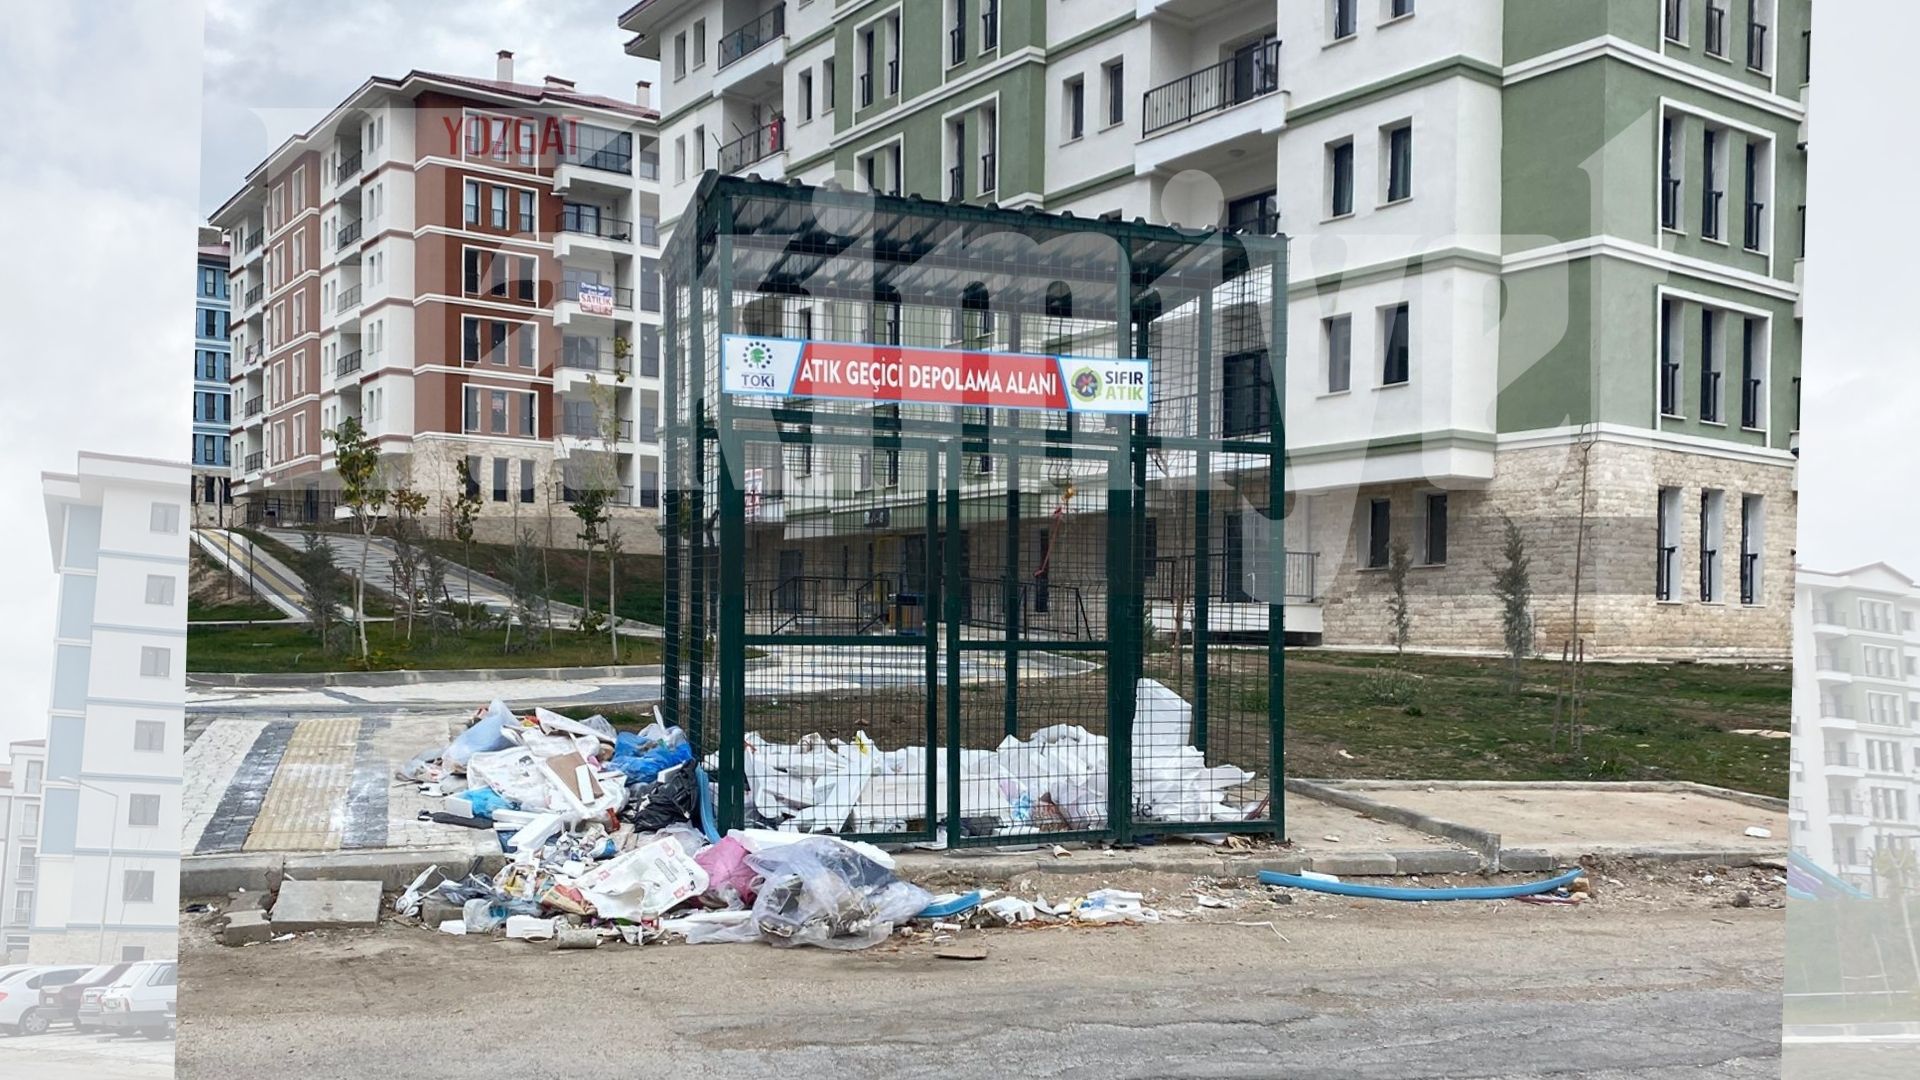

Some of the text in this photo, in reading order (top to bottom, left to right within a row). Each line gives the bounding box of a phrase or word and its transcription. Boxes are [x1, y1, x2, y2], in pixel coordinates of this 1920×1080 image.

[800, 356, 1056, 396] ATIK GEÇİCİ DEPOLAMA ALANI
[1105, 371, 1144, 385] SIFIR
[1105, 386, 1144, 401] ATIK
